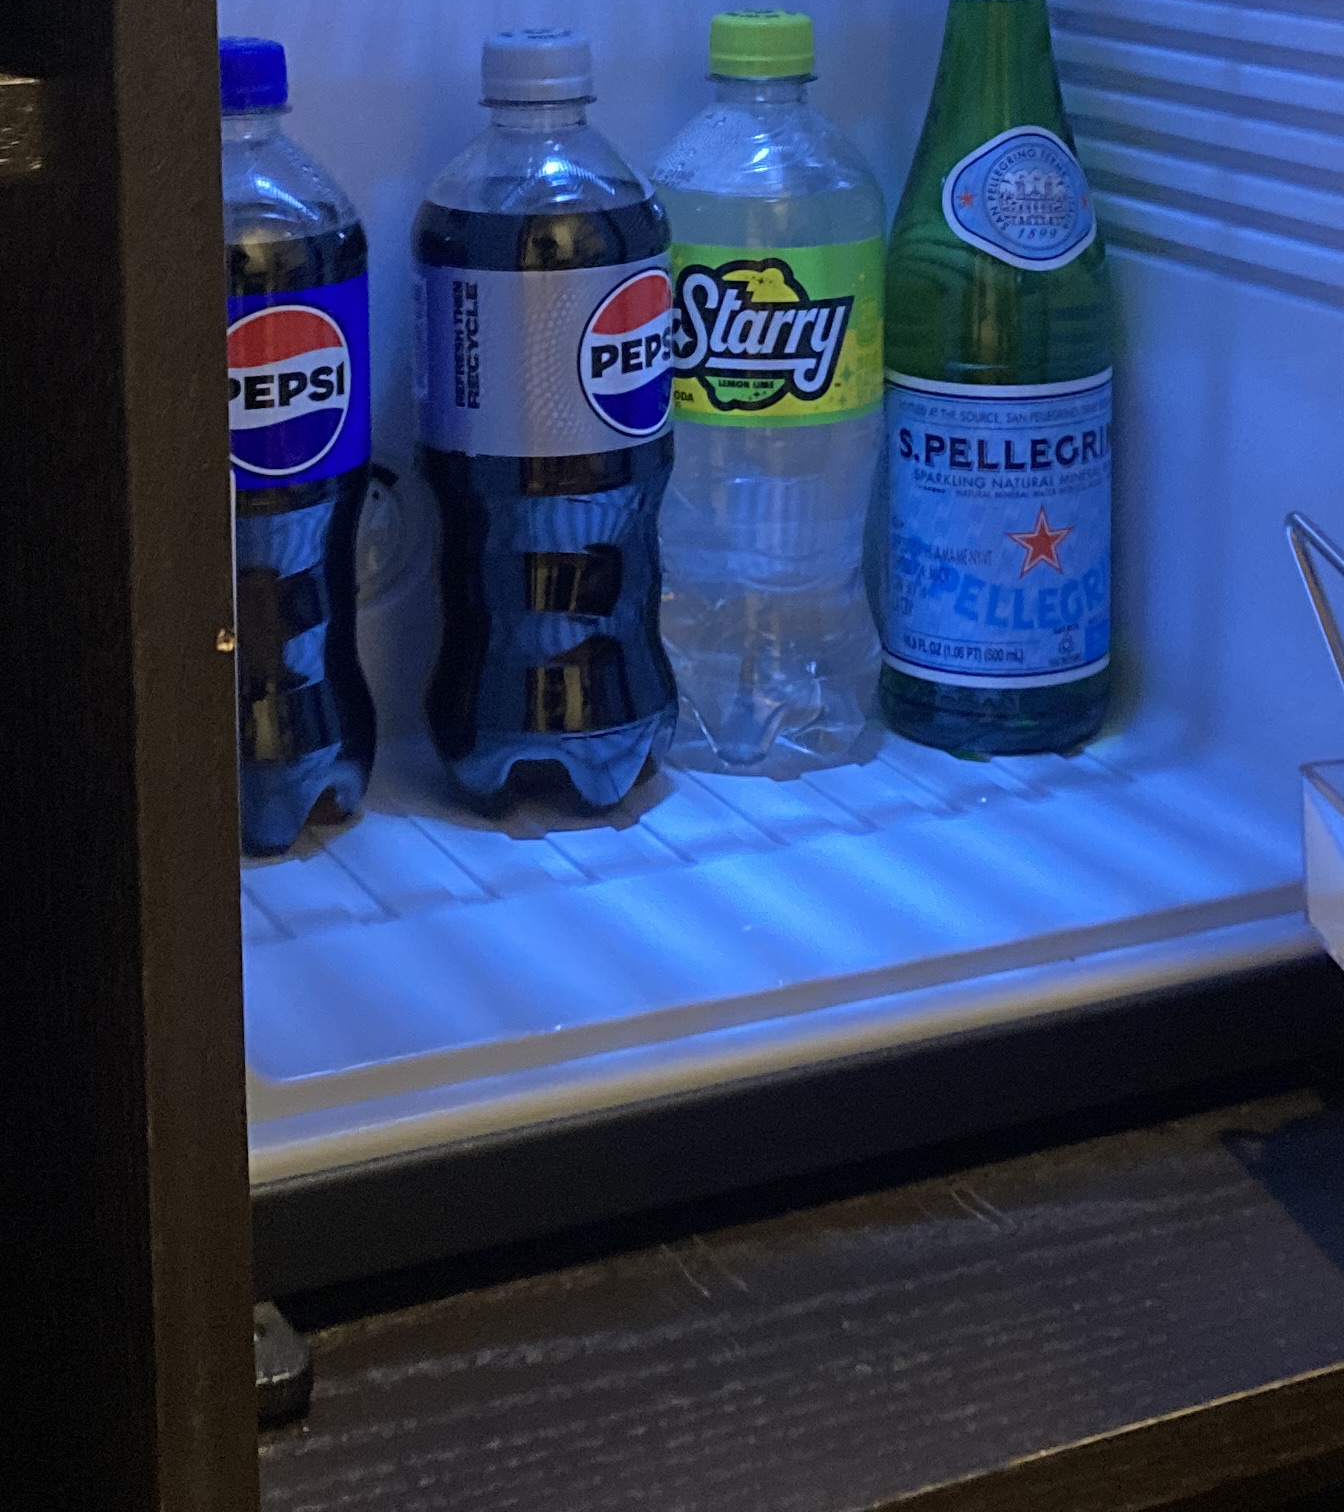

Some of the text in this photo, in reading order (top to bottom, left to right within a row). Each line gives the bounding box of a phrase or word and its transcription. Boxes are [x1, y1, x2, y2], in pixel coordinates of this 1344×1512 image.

[987, 148, 1037, 201] PELLEGRINO
[465, 281, 480, 409] RECYCLE
[672, 273, 845, 392] Starry
[718, 379, 749, 389] LEMON
[914, 468, 987, 490] SPARKLING
[991, 473, 1055, 490] NATURAL
